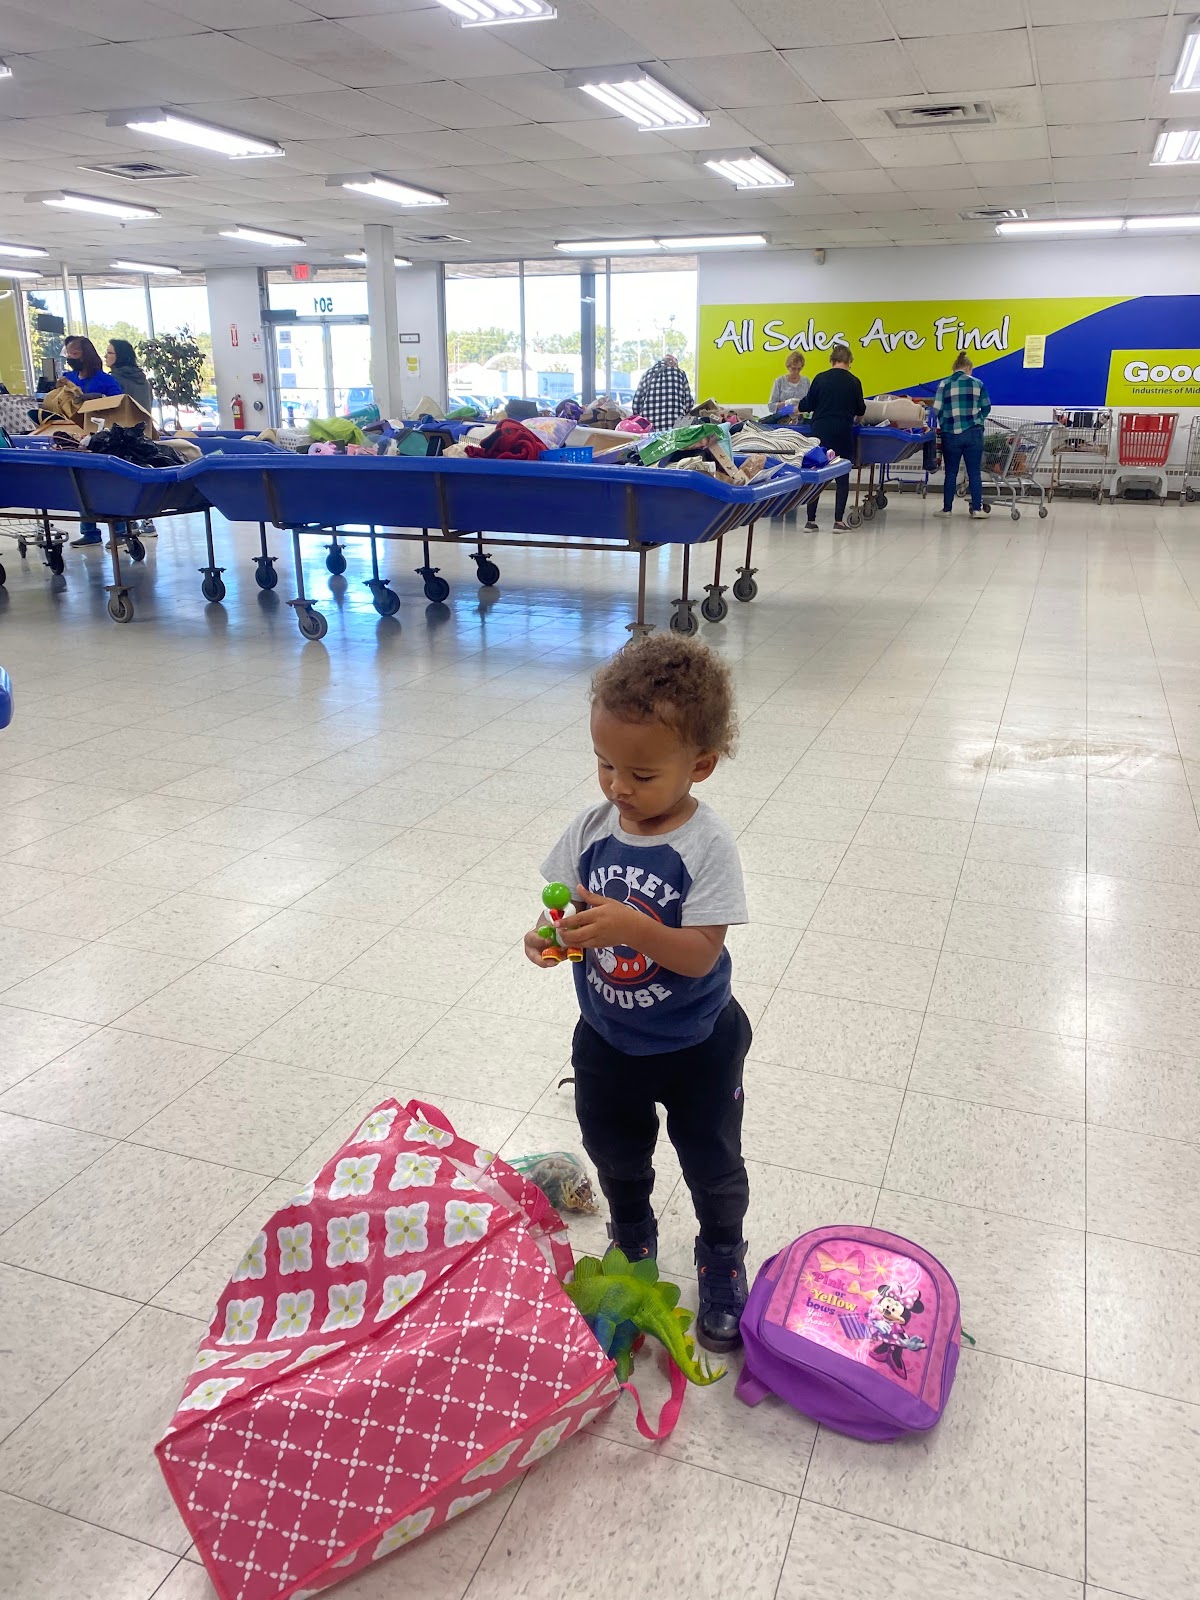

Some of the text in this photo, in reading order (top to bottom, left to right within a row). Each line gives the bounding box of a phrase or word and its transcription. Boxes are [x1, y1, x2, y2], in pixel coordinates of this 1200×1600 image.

[713, 319, 754, 354] All
[762, 318, 850, 352] Sales
[859, 317, 926, 353] Are
[933, 315, 1010, 351] Final
[1132, 387, 1173, 395] Industries
[1174, 387, 1184, 395] of
[588, 864, 681, 908] MICKEY
[587, 969, 673, 1010] MOUSE
[812, 1271, 845, 1291] Pink
[806, 1297, 836, 1315] bows
[811, 1289, 858, 1312] Yellow
[807, 1308, 824, 1318] You
